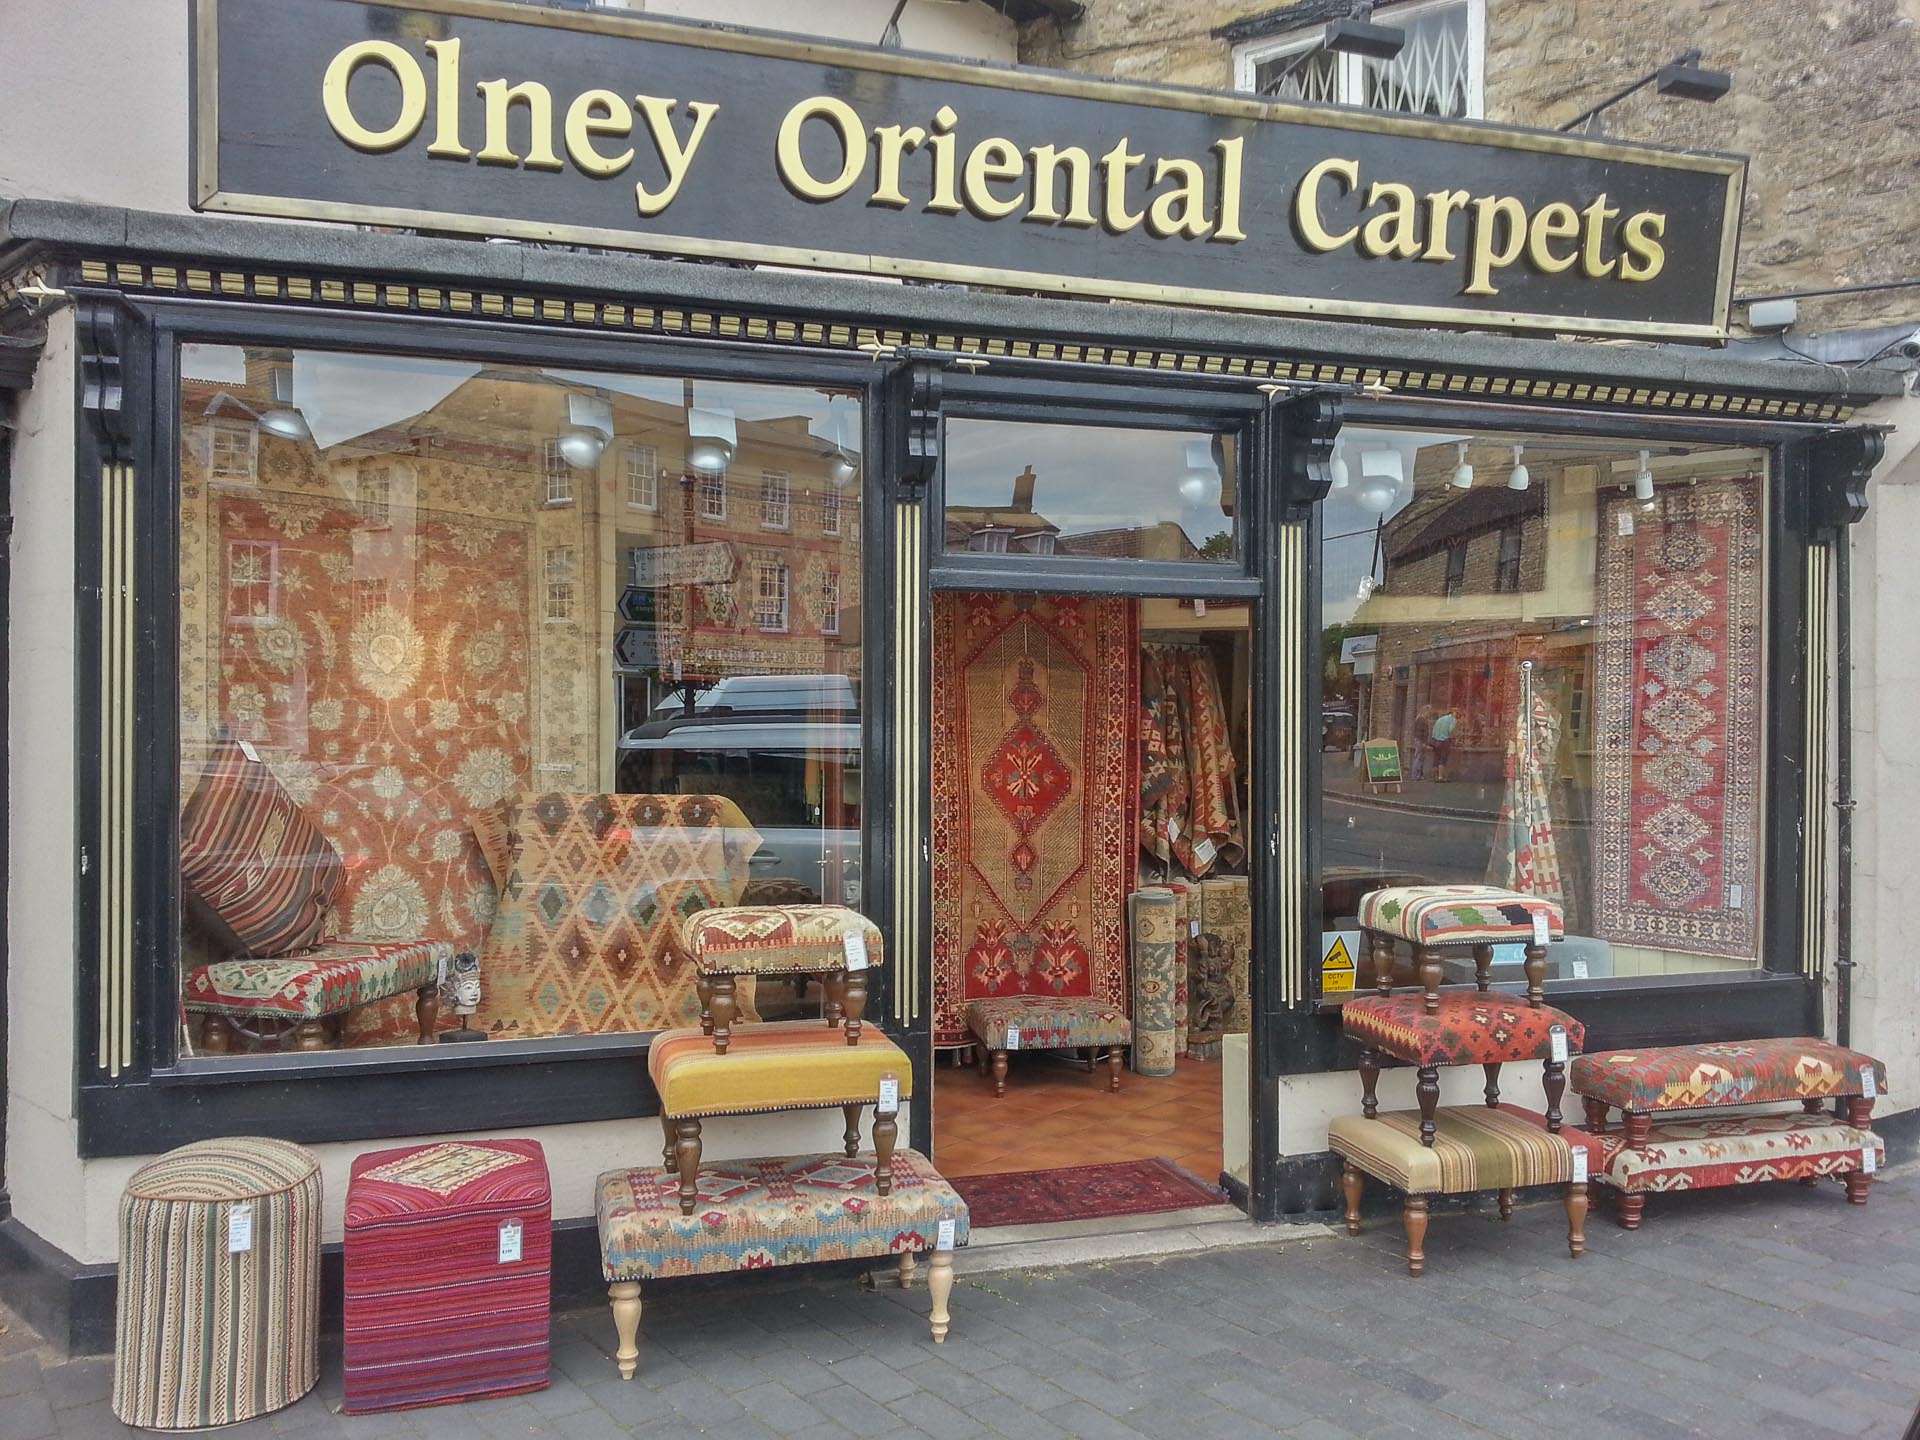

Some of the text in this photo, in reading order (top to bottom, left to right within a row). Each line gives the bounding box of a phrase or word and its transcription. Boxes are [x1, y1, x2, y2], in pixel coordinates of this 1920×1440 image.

[323, 36, 1667, 297] Olney Oriental Carpets
